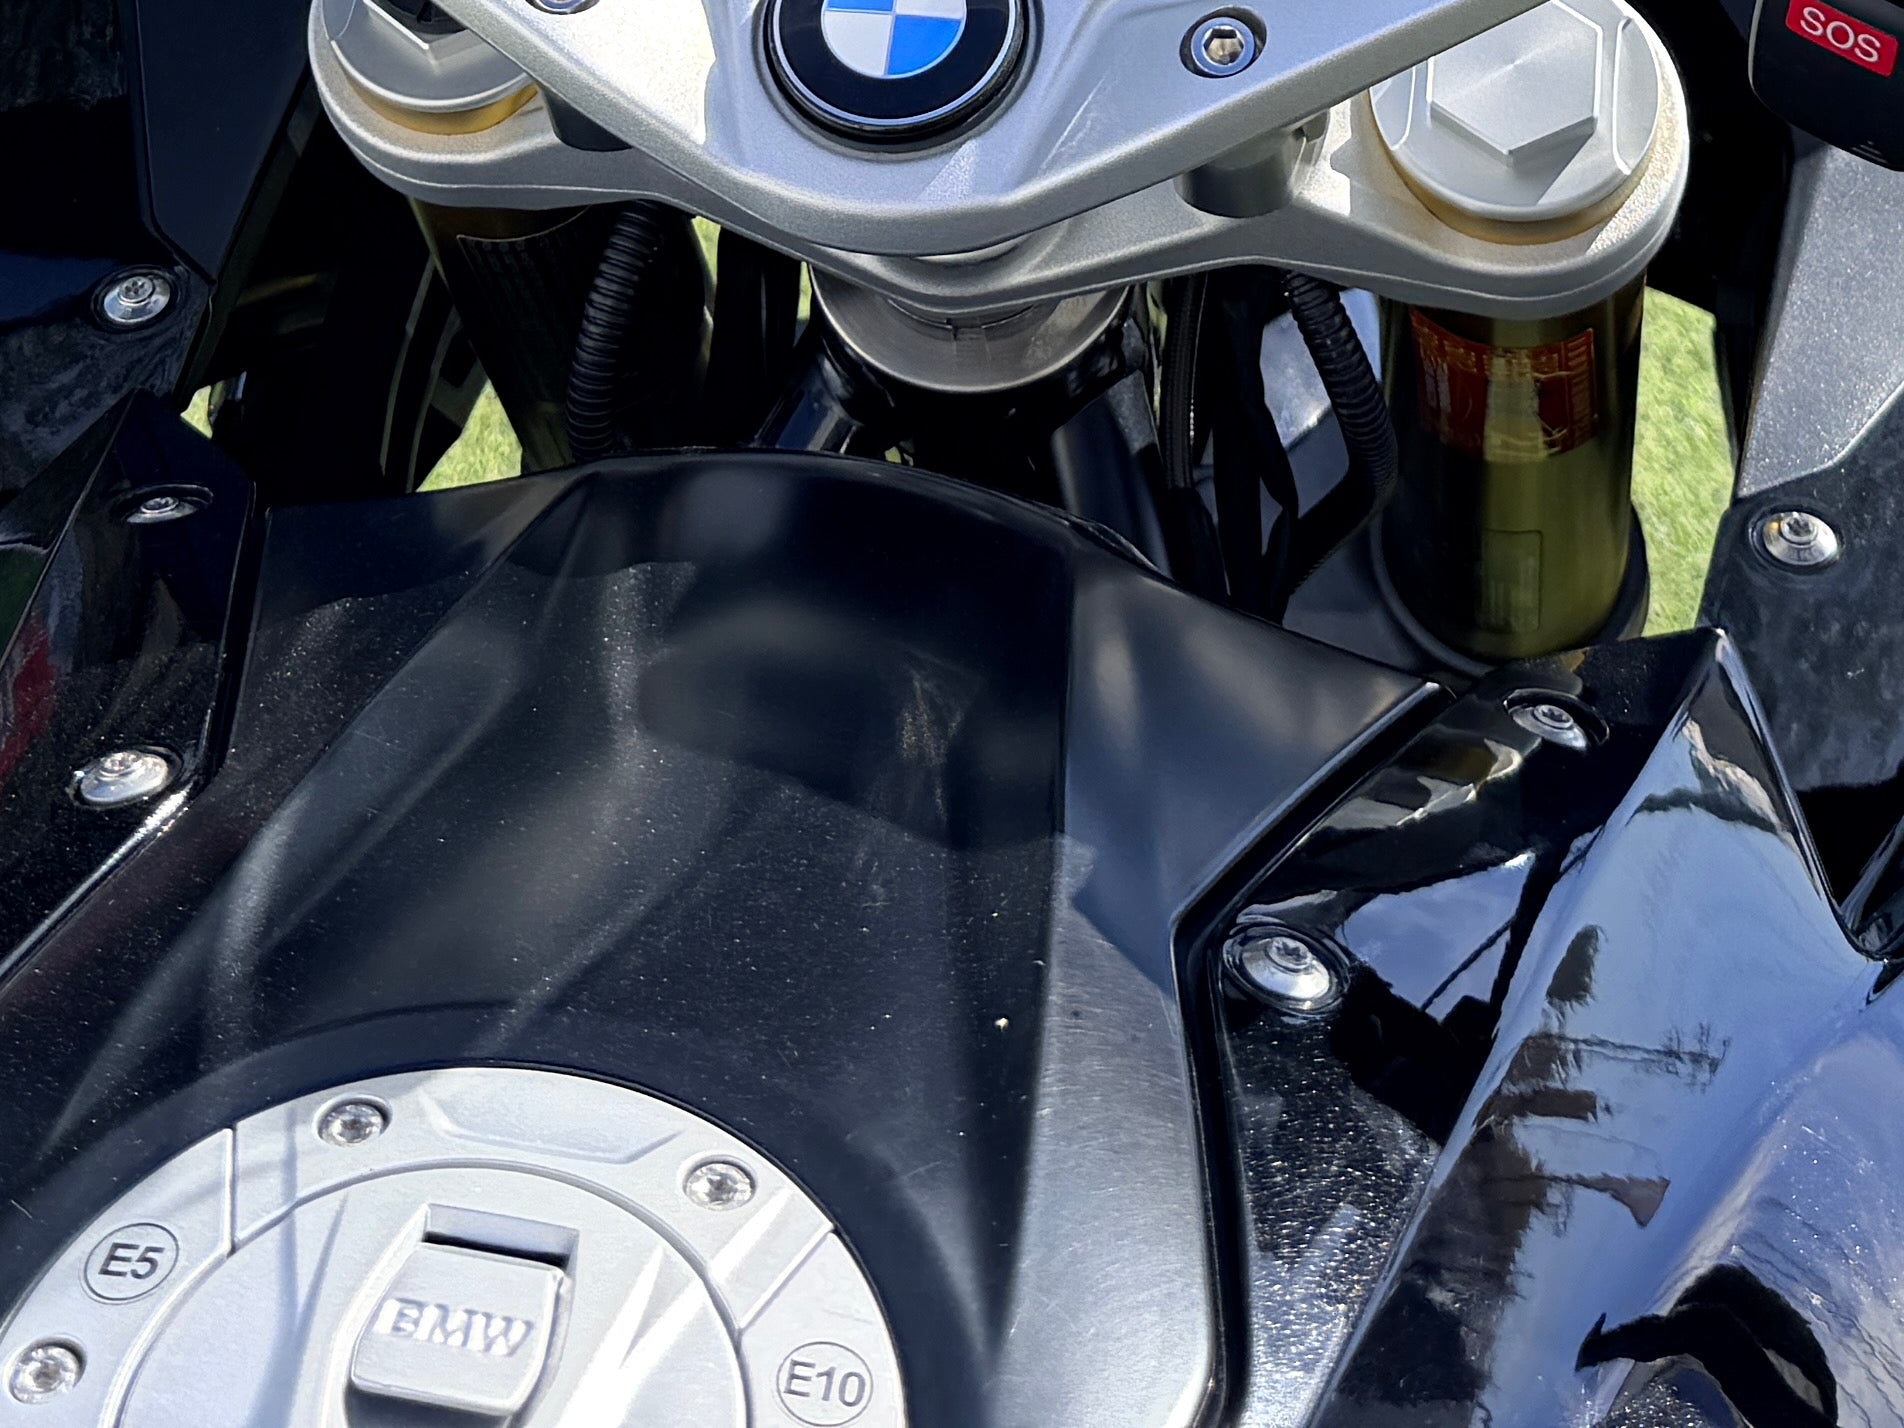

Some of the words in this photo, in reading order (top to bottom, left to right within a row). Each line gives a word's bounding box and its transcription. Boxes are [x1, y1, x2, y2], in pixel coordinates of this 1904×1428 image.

[1800, 6, 1882, 63] SOS
[98, 1242, 164, 1280] E5
[376, 1296, 535, 1358] BMW
[783, 1358, 866, 1407] E10
